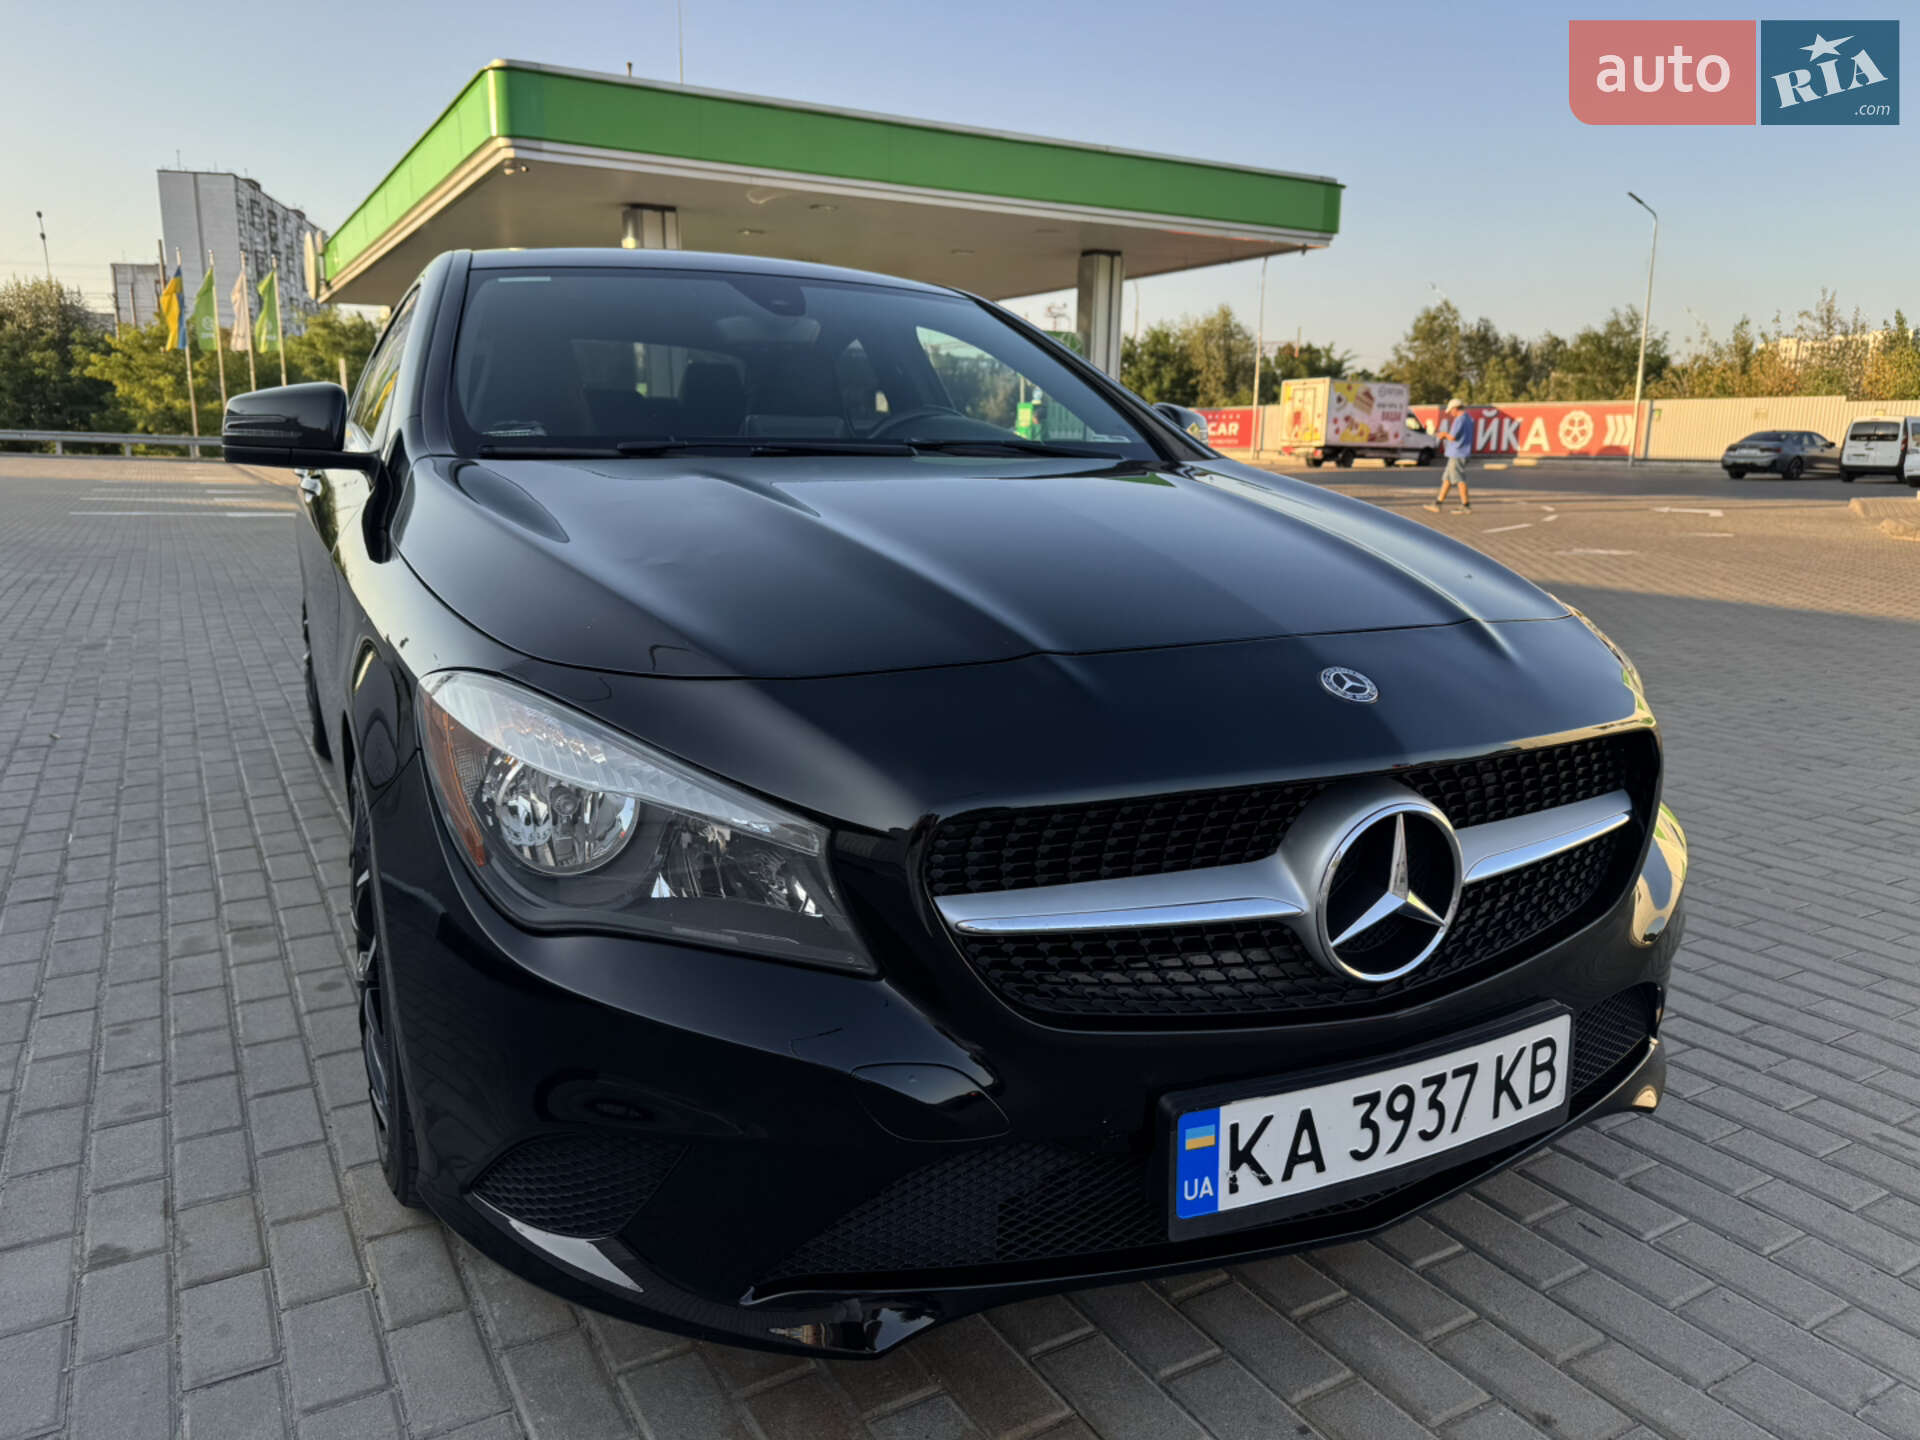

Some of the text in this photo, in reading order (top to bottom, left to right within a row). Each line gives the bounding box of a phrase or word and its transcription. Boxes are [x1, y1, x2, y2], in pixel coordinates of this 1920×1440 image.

[1229, 1035, 1557, 1195] KA 3937 KB
[1183, 1176, 1214, 1201] UA
